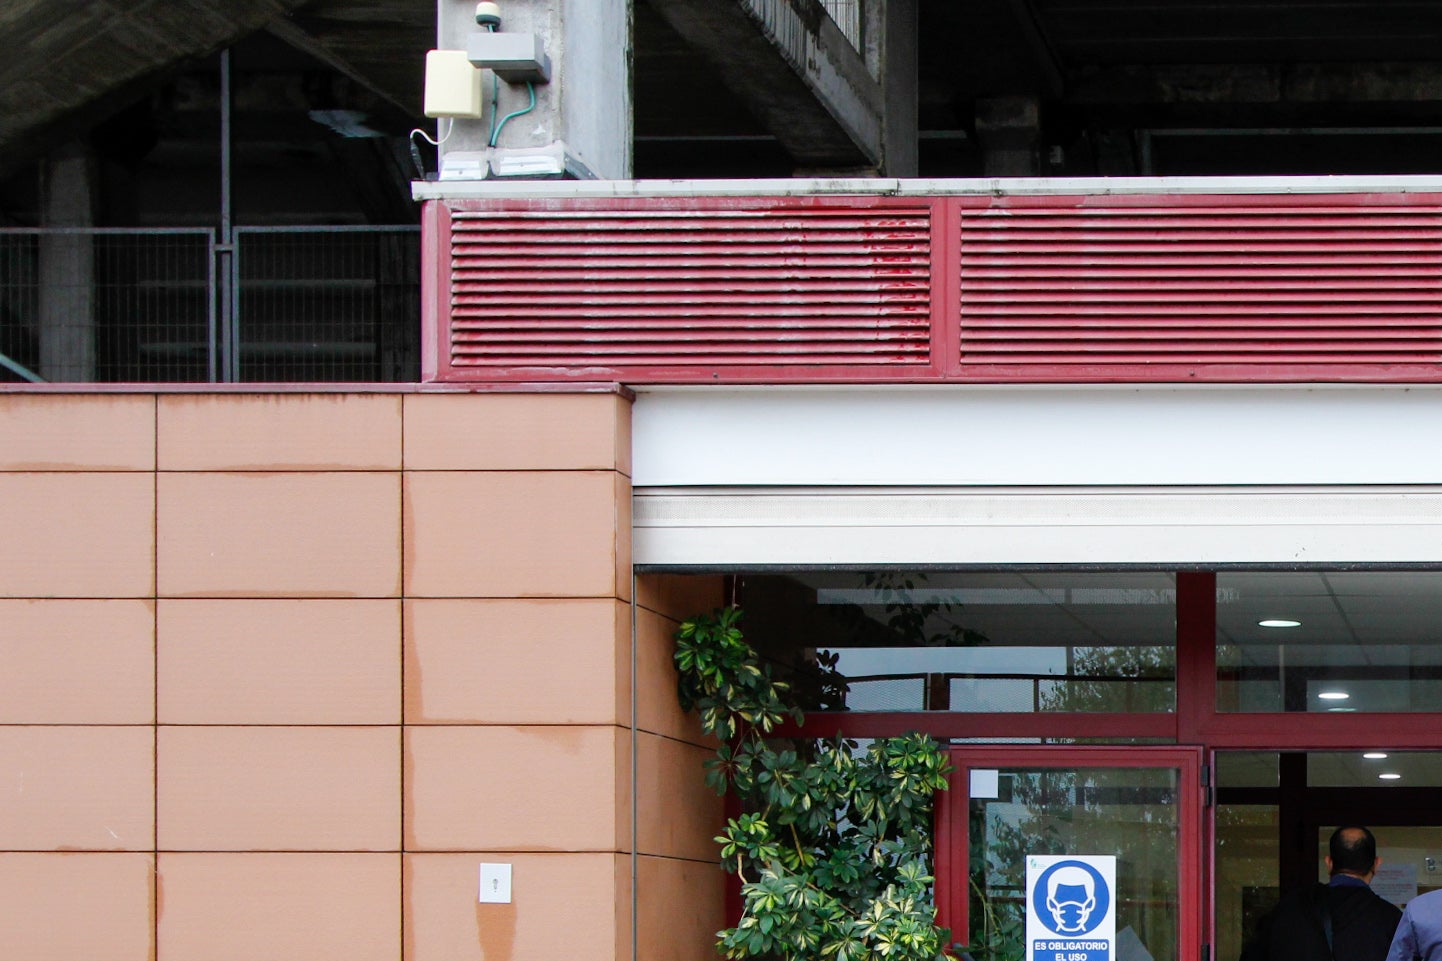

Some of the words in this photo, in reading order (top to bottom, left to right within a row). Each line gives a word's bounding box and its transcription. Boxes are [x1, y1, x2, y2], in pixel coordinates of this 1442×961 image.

[1034, 942, 1047, 950] ES
[1048, 942, 1108, 950] OBLIGATORIO
[1055, 953, 1067, 961] EL
[1068, 953, 1087, 961] USO
